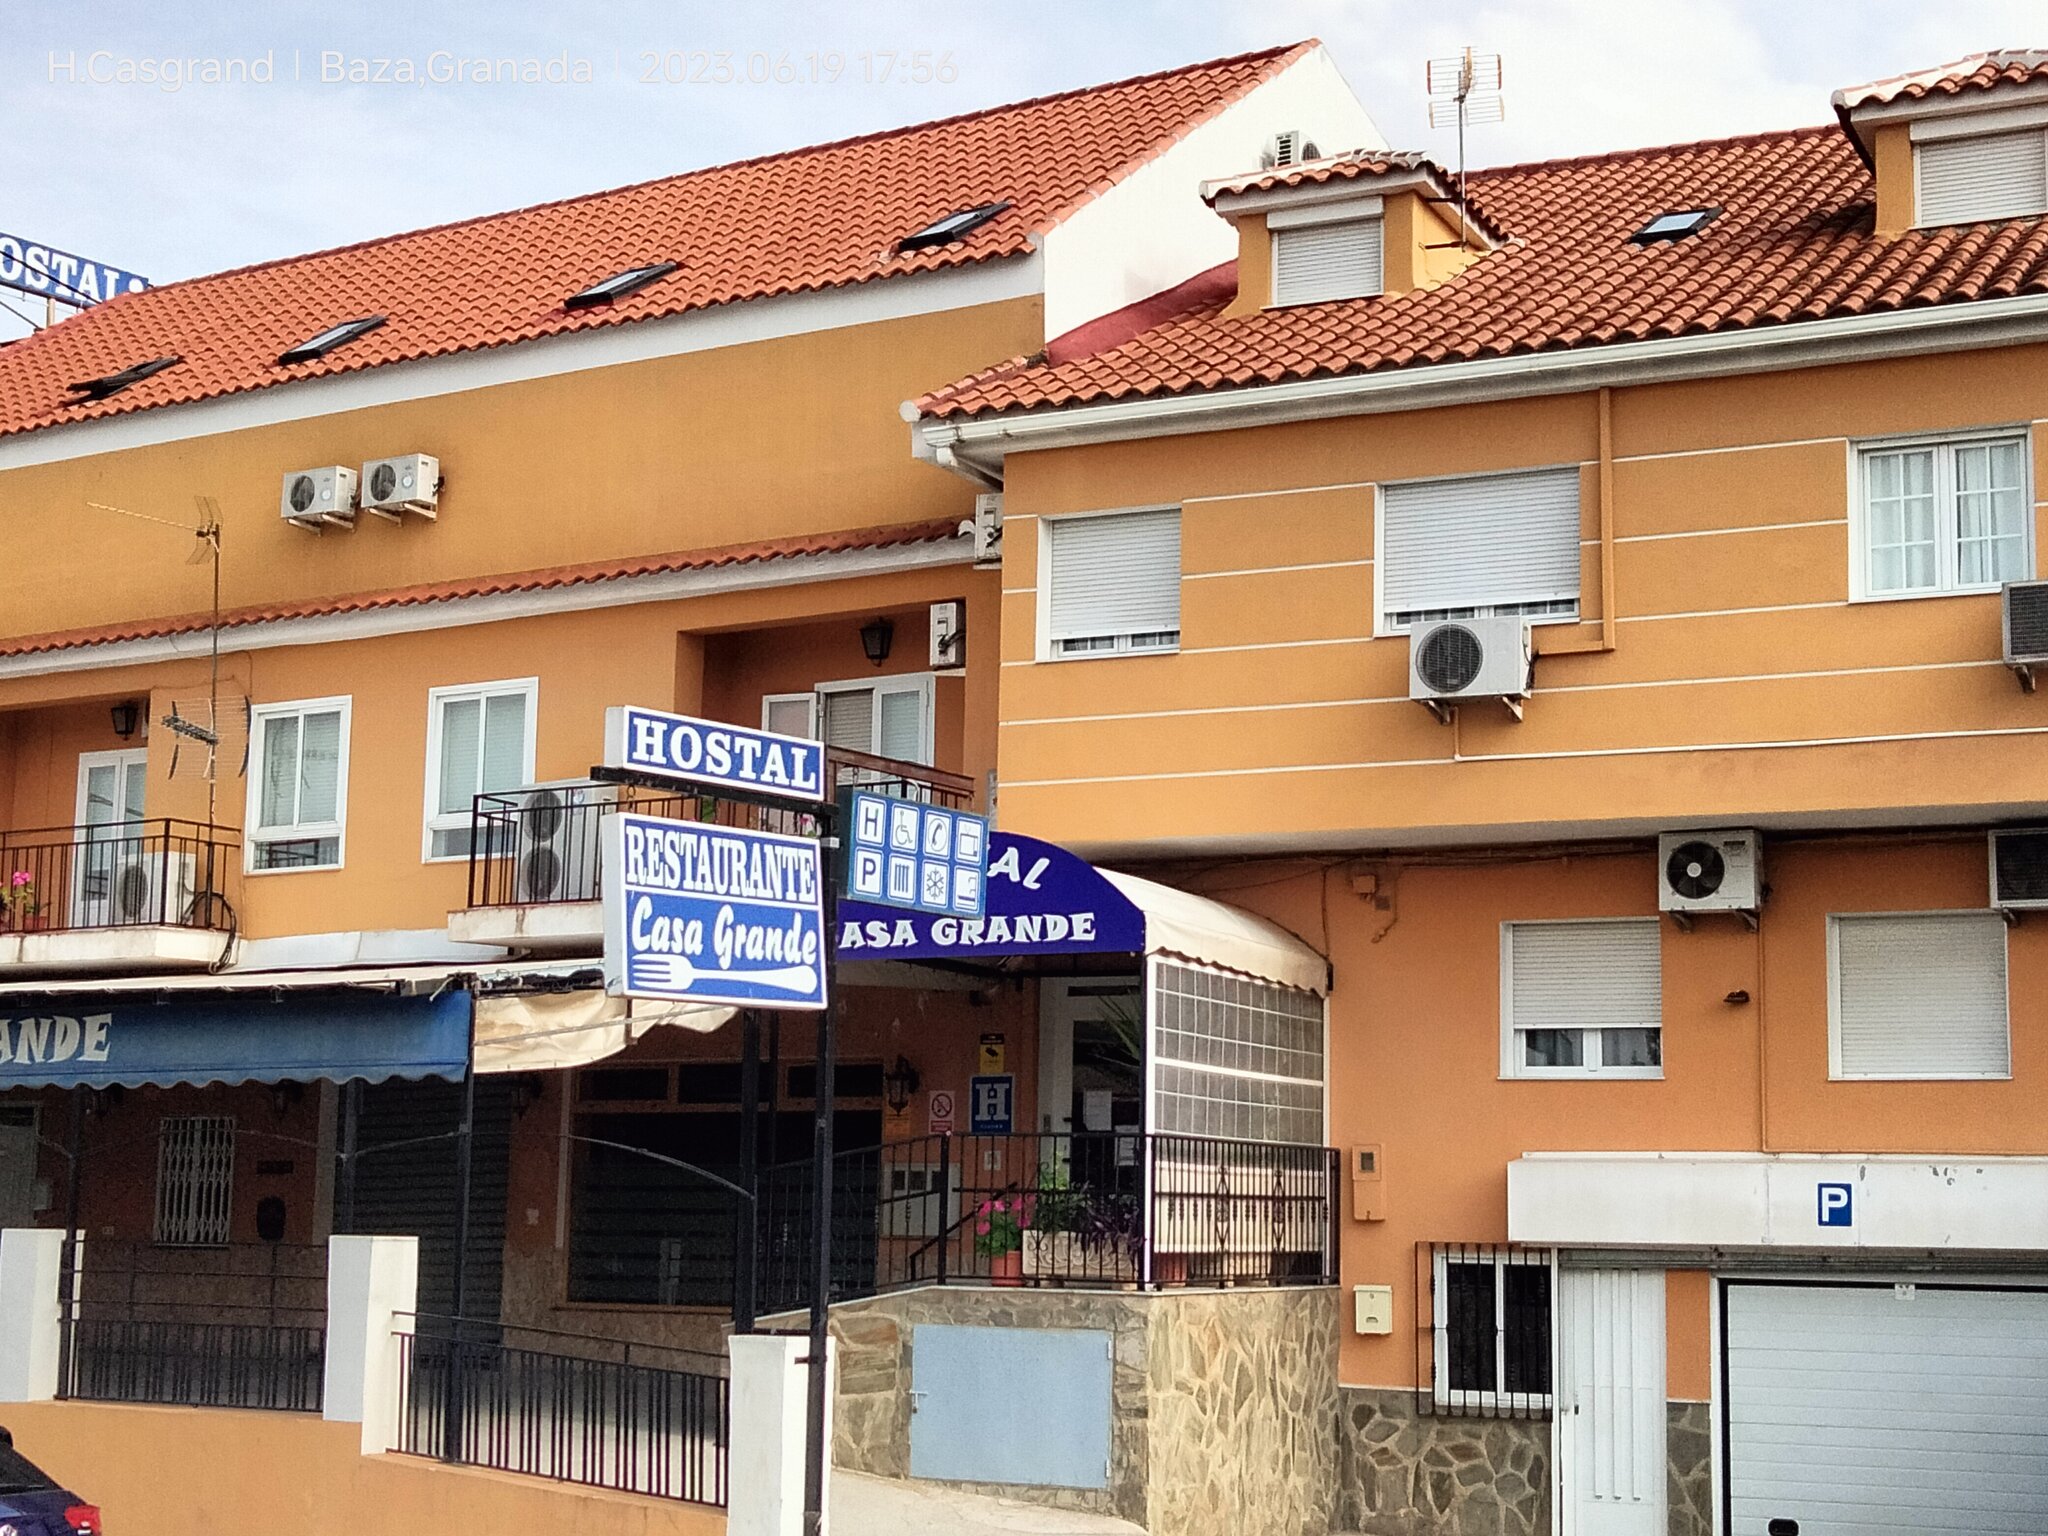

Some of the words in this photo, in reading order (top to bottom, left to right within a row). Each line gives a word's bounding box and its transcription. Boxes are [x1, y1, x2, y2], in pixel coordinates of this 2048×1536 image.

[631, 717, 816, 790] HOSTAL
[863, 806, 880, 844] H
[625, 825, 816, 903] RESTAURANTE
[861, 857, 877, 886] P
[987, 845, 1050, 890] AL
[631, 895, 704, 956] Casa
[713, 904, 817, 970] Grande
[835, 919, 919, 949] ASA
[931, 913, 1096, 947] GRANDE
[975, 1083, 1010, 1121] H
[1821, 1187, 1849, 1223] P
